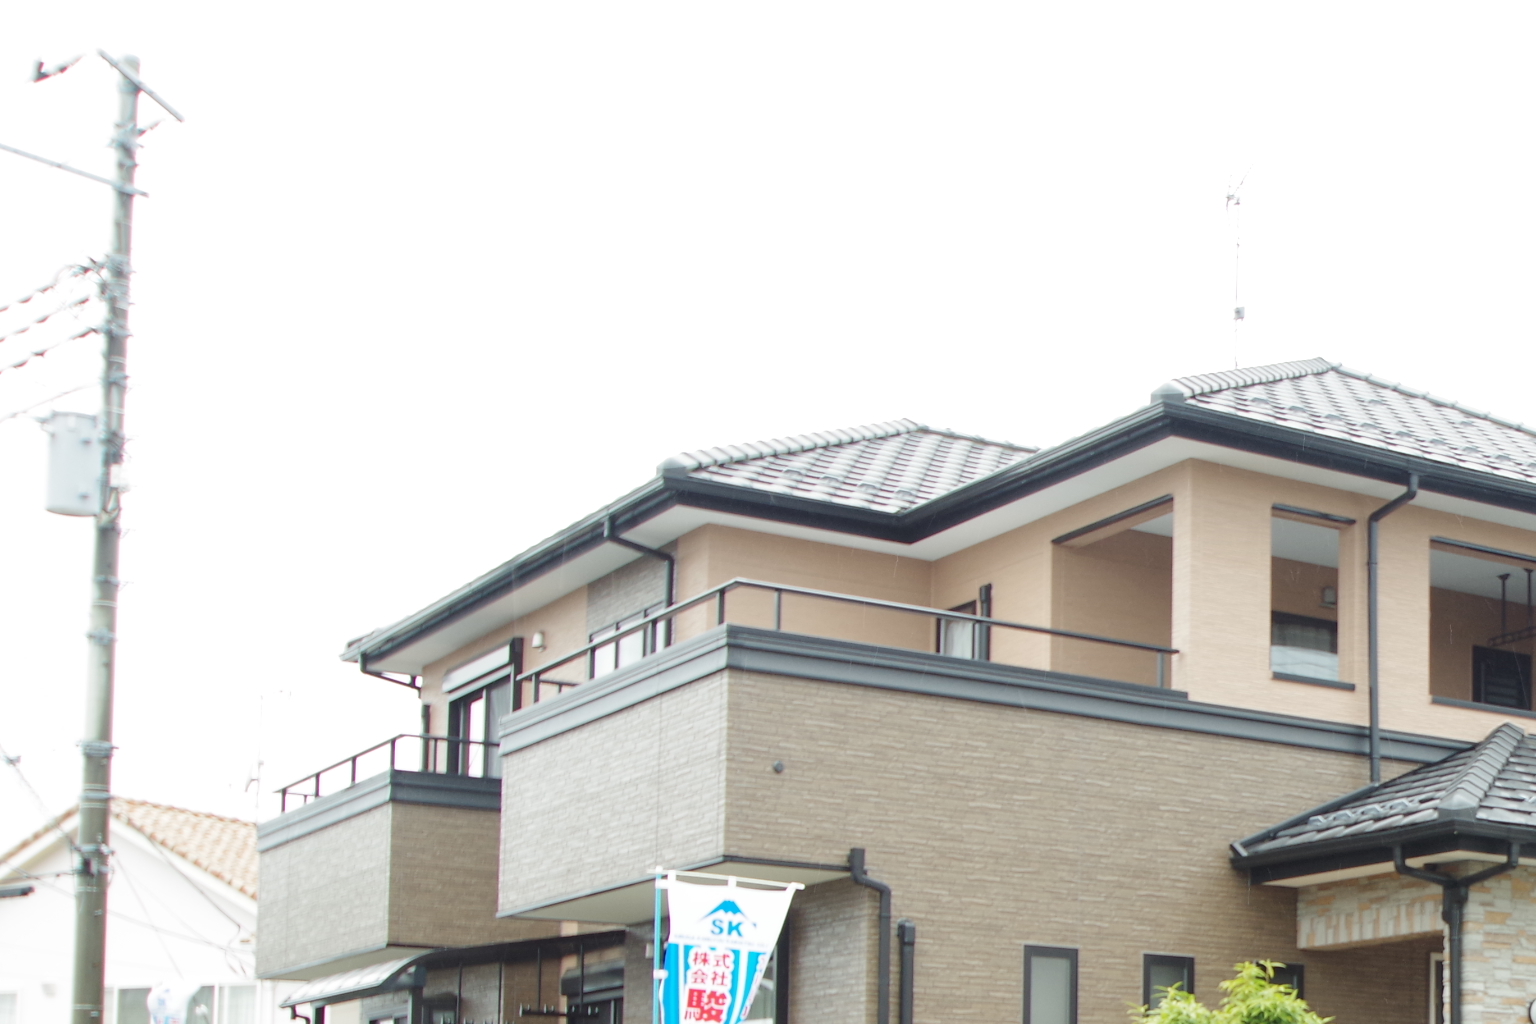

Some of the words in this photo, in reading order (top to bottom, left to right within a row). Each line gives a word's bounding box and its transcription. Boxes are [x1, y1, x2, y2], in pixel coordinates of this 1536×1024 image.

[710, 919, 744, 938] SK
[693, 951, 731, 969] 株式
[691, 968, 728, 986] 会社
